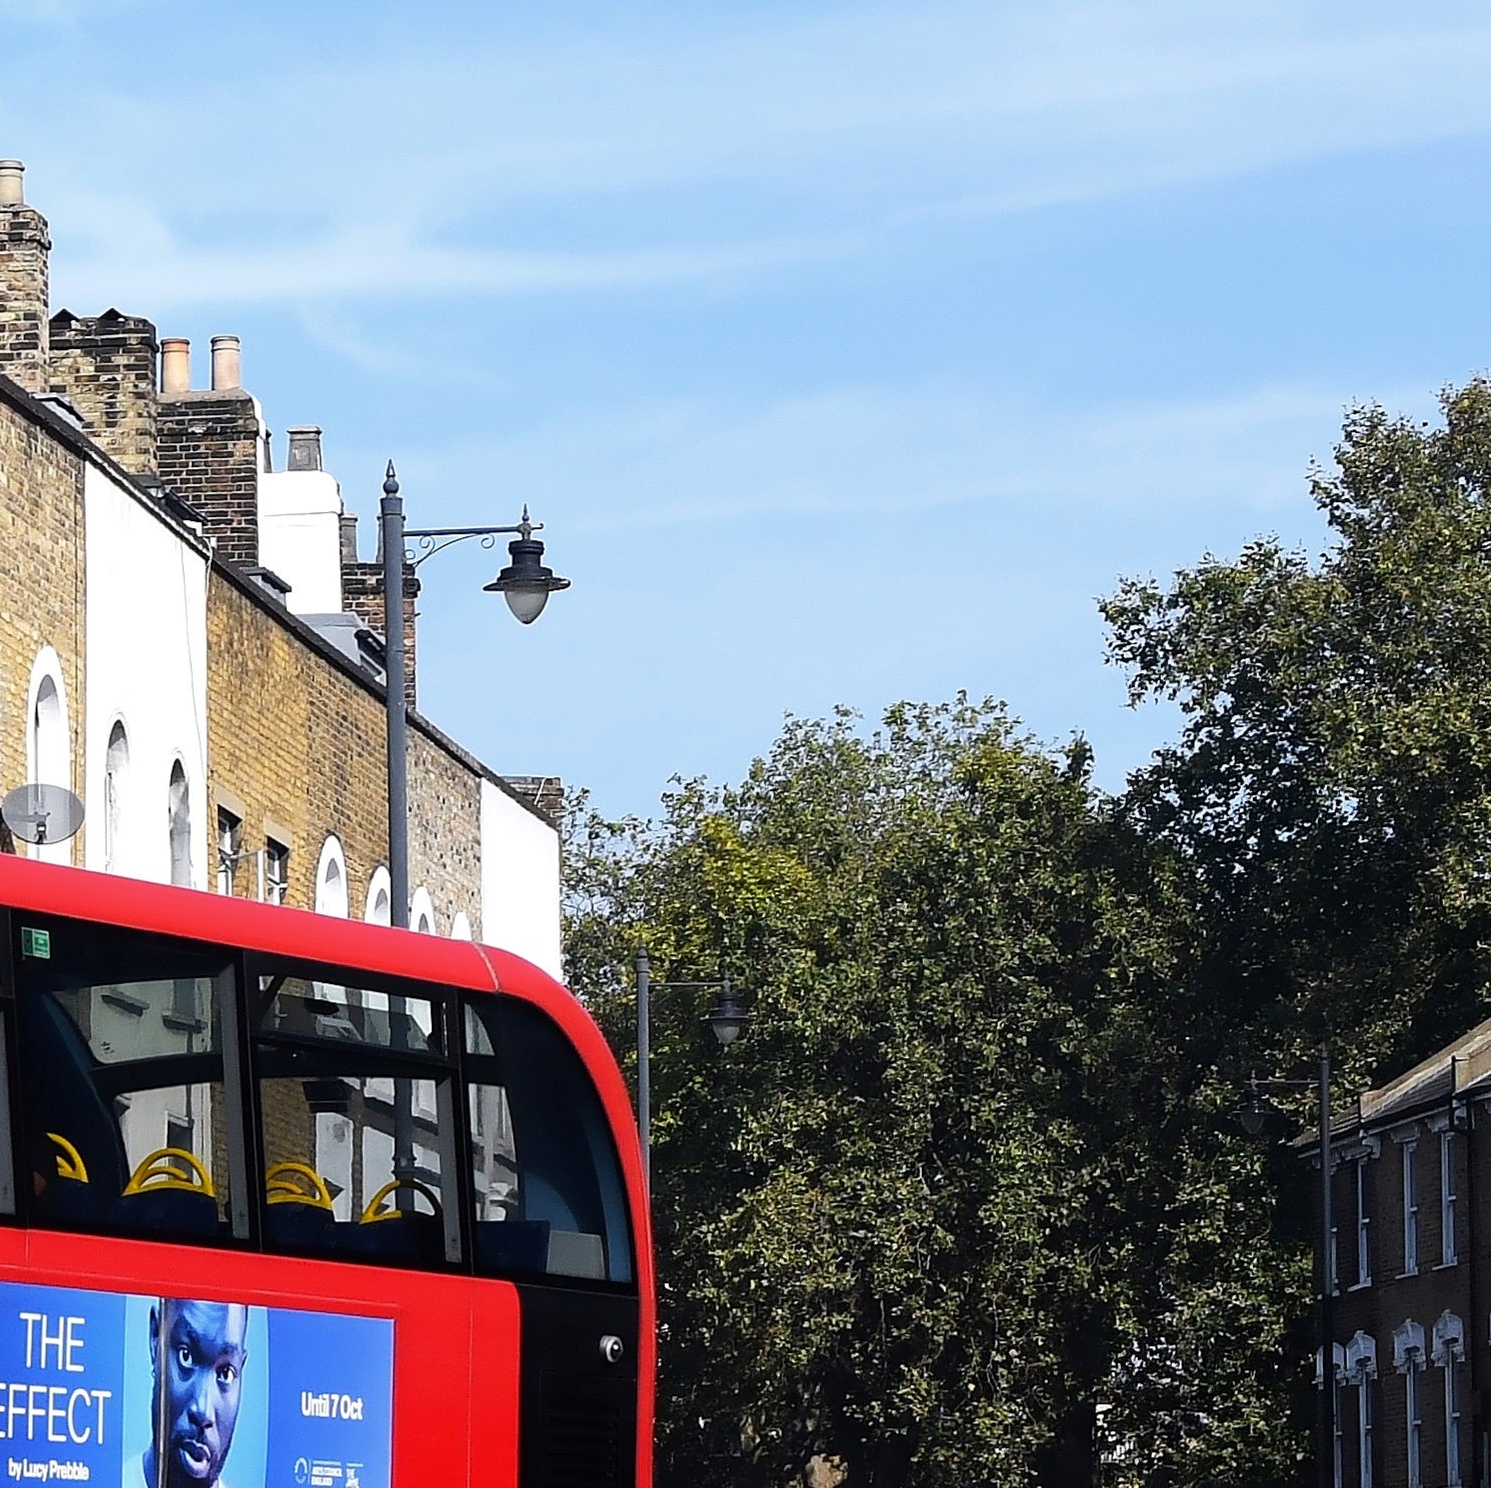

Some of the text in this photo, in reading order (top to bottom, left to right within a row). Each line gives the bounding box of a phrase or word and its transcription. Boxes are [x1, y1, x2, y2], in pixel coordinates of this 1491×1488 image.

[19, 1312, 86, 1373] THE
[301, 1391, 363, 1421] Until 7 Oct
[8, 1457, 90, 1482] by Lucy Prebble
